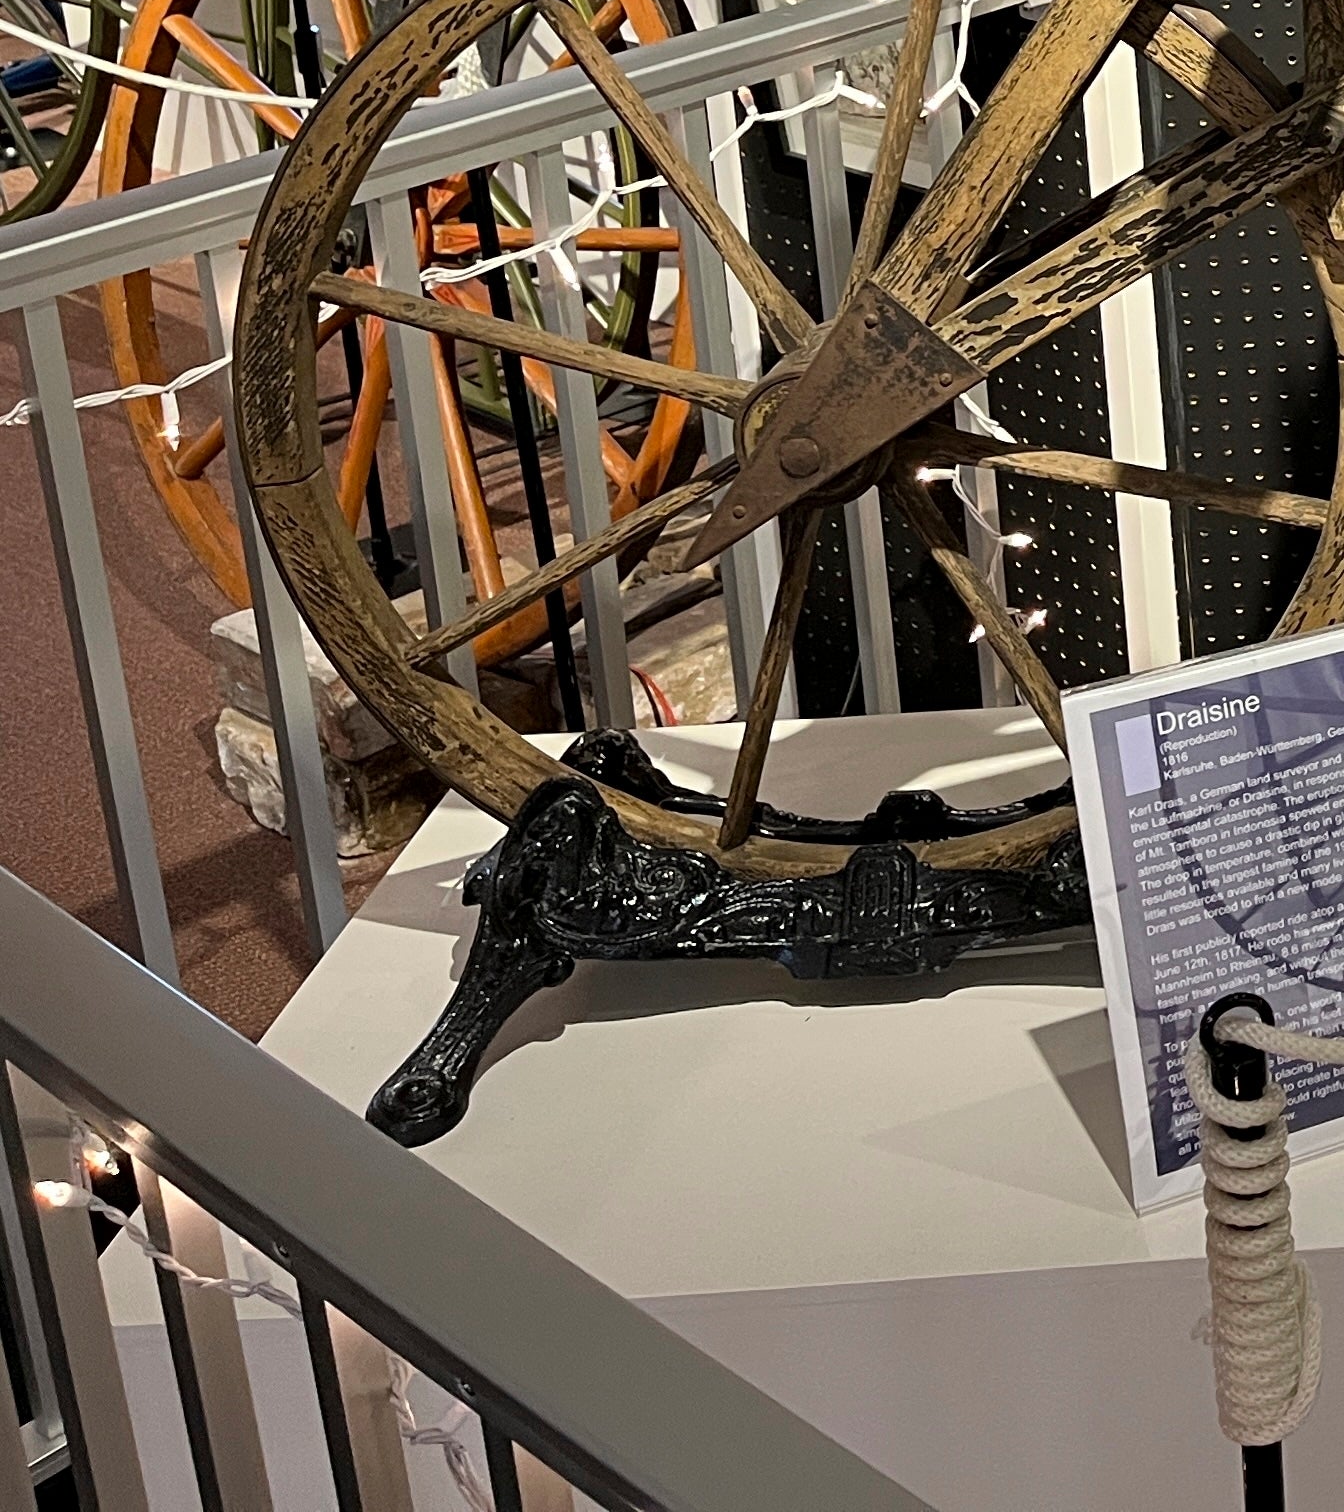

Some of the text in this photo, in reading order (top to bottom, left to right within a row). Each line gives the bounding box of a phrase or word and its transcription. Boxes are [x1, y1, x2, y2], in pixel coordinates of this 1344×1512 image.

[1156, 695, 1260, 734] Draisine
[1159, 725, 1237, 754] (Reproduction)
[1162, 753, 1187, 766] 1816
[1129, 804, 1151, 817] Karl
[1200, 782, 1244, 799] German
[1247, 773, 1270, 786] land
[1273, 762, 1319, 779] surveyor
[1322, 754, 1341, 767] and
[1131, 821, 1148, 832] the
[1229, 798, 1239, 806] or
[1293, 781, 1302, 789] in
[1133, 819, 1210, 847] environmental
[1283, 795, 1304, 806] The
[1135, 851, 1146, 861] of
[1169, 834, 1217, 852] Tambora
[1220, 830, 1230, 838] in
[1289, 801, 1330, 821] spewed
[1138, 853, 1203, 876] atmosphere
[1206, 849, 1216, 857] to
[1220, 839, 1252, 854] cause
[1265, 826, 1301, 841] drastic
[1303, 821, 1320, 831] dip
[1323, 817, 1332, 825] in
[1140, 879, 1161, 891] The
[1164, 872, 1190, 884] drop
[1192, 868, 1202, 876] in
[1277, 831, 1328, 853] combined
[1189, 884, 1199, 892] in
[1202, 878, 1219, 889] the
[1301, 851, 1311, 861] of
[1314, 848, 1330, 858] the
[1147, 921, 1176, 935] Drais
[1179, 914, 1201, 926] was
[1204, 902, 1238, 919] forced
[1241, 900, 1251, 908] to
[1254, 892, 1274, 904] find
[1287, 884, 1308, 895] new
[1312, 875, 1341, 888] mode
[1170, 893, 1224, 913] resources
[1227, 878, 1275, 897] available
[1278, 870, 1298, 883] and
[1301, 863, 1331, 876] many
[1151, 953, 1169, 964] His
[1172, 945, 1192, 958] first
[1196, 934, 1237, 954] publicly
[1240, 918, 1285, 939] reported
[1288, 913, 1308, 925] ride
[1311, 906, 1335, 918] atop
[1153, 966, 1180, 979] June
[1248, 942, 1264, 951] He
[1267, 933, 1291, 946] rode
[1156, 971, 1213, 993] Mannheim
[1216, 967, 1227, 976] to
[1281, 945, 1298, 957] 8.6
[1158, 994, 1189, 1008] faster
[1192, 986, 1216, 998] than
[1267, 963, 1287, 976] and
[1275, 1062, 1313, 1081] placing
